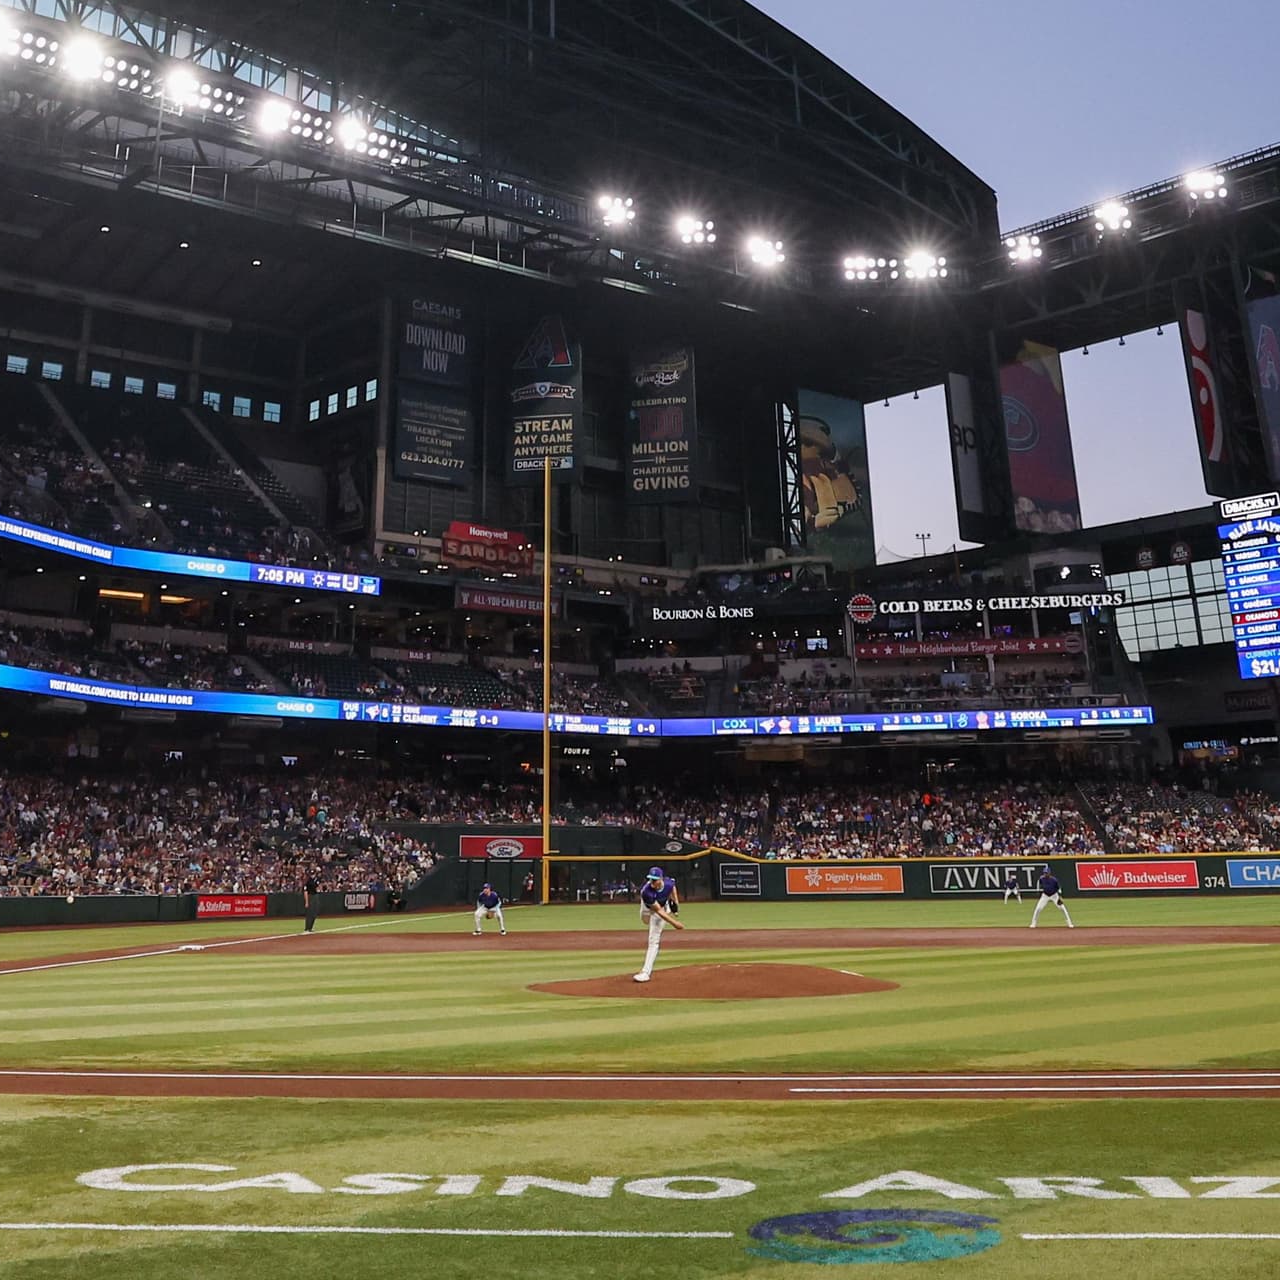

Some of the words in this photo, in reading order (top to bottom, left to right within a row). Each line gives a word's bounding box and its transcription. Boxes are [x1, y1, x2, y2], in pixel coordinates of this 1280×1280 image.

[406, 323, 466, 355] DOWNLOAD
[422, 349, 448, 372] NOW
[514, 419, 572, 433] STREAM
[514, 435, 538, 445] ANY
[541, 433, 572, 443] GAME
[514, 445, 573, 456] ANYWHERE
[632, 441, 688, 455] MILLION
[401, 452, 464, 469] 623.304.0777
[656, 456, 665, 464] IN
[633, 466, 688, 475] CHARITABLE
[633, 476, 689, 490] GIVING
[1225, 497, 1275, 514] DBACKS.TV
[469, 526, 508, 540] Honeywell
[447, 541, 532, 566] SANDLOT
[257, 568, 284, 583] 7:05
[286, 570, 304, 584] PM
[880, 601, 919, 613] COLD
[923, 599, 972, 612] BEERS
[976, 600, 985, 611] &
[988, 594, 1122, 610] CHEESEBURGERS
[653, 608, 703, 620] BOURBON
[706, 607, 717, 618] &
[720, 606, 753, 618] BONES
[825, 873, 854, 884] Dignity
[856, 872, 884, 881] Health
[1124, 871, 1187, 885] Budweiser
[1204, 877, 1225, 888] 374
[74, 1162, 757, 1201] CASINO
